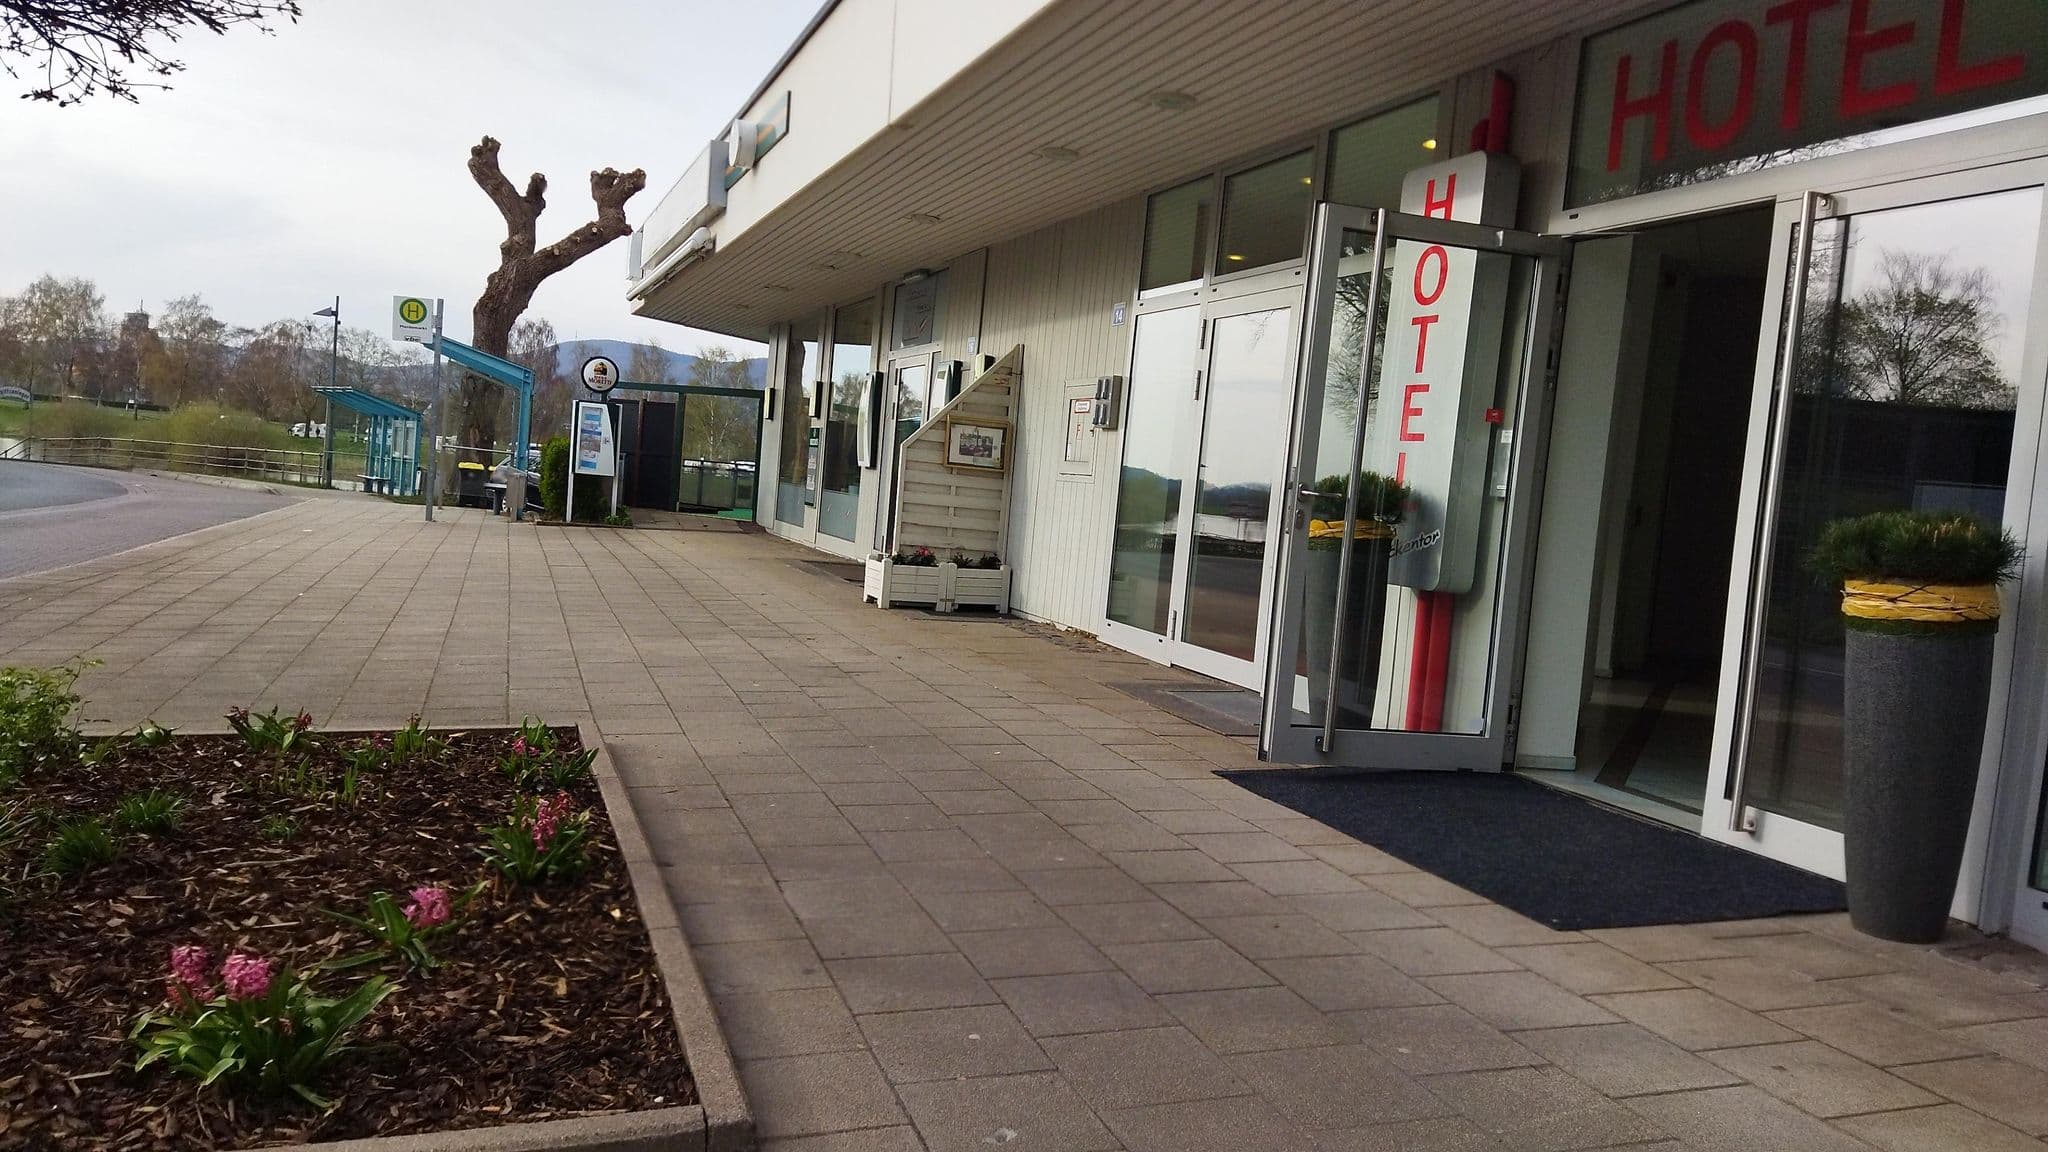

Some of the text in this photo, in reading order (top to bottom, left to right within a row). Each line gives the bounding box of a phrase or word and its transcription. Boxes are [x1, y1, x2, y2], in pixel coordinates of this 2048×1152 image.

[1606, 0, 2026, 173] HOTEL
[408, 303, 419, 319] H
[1114, 309, 1123, 323] 14
